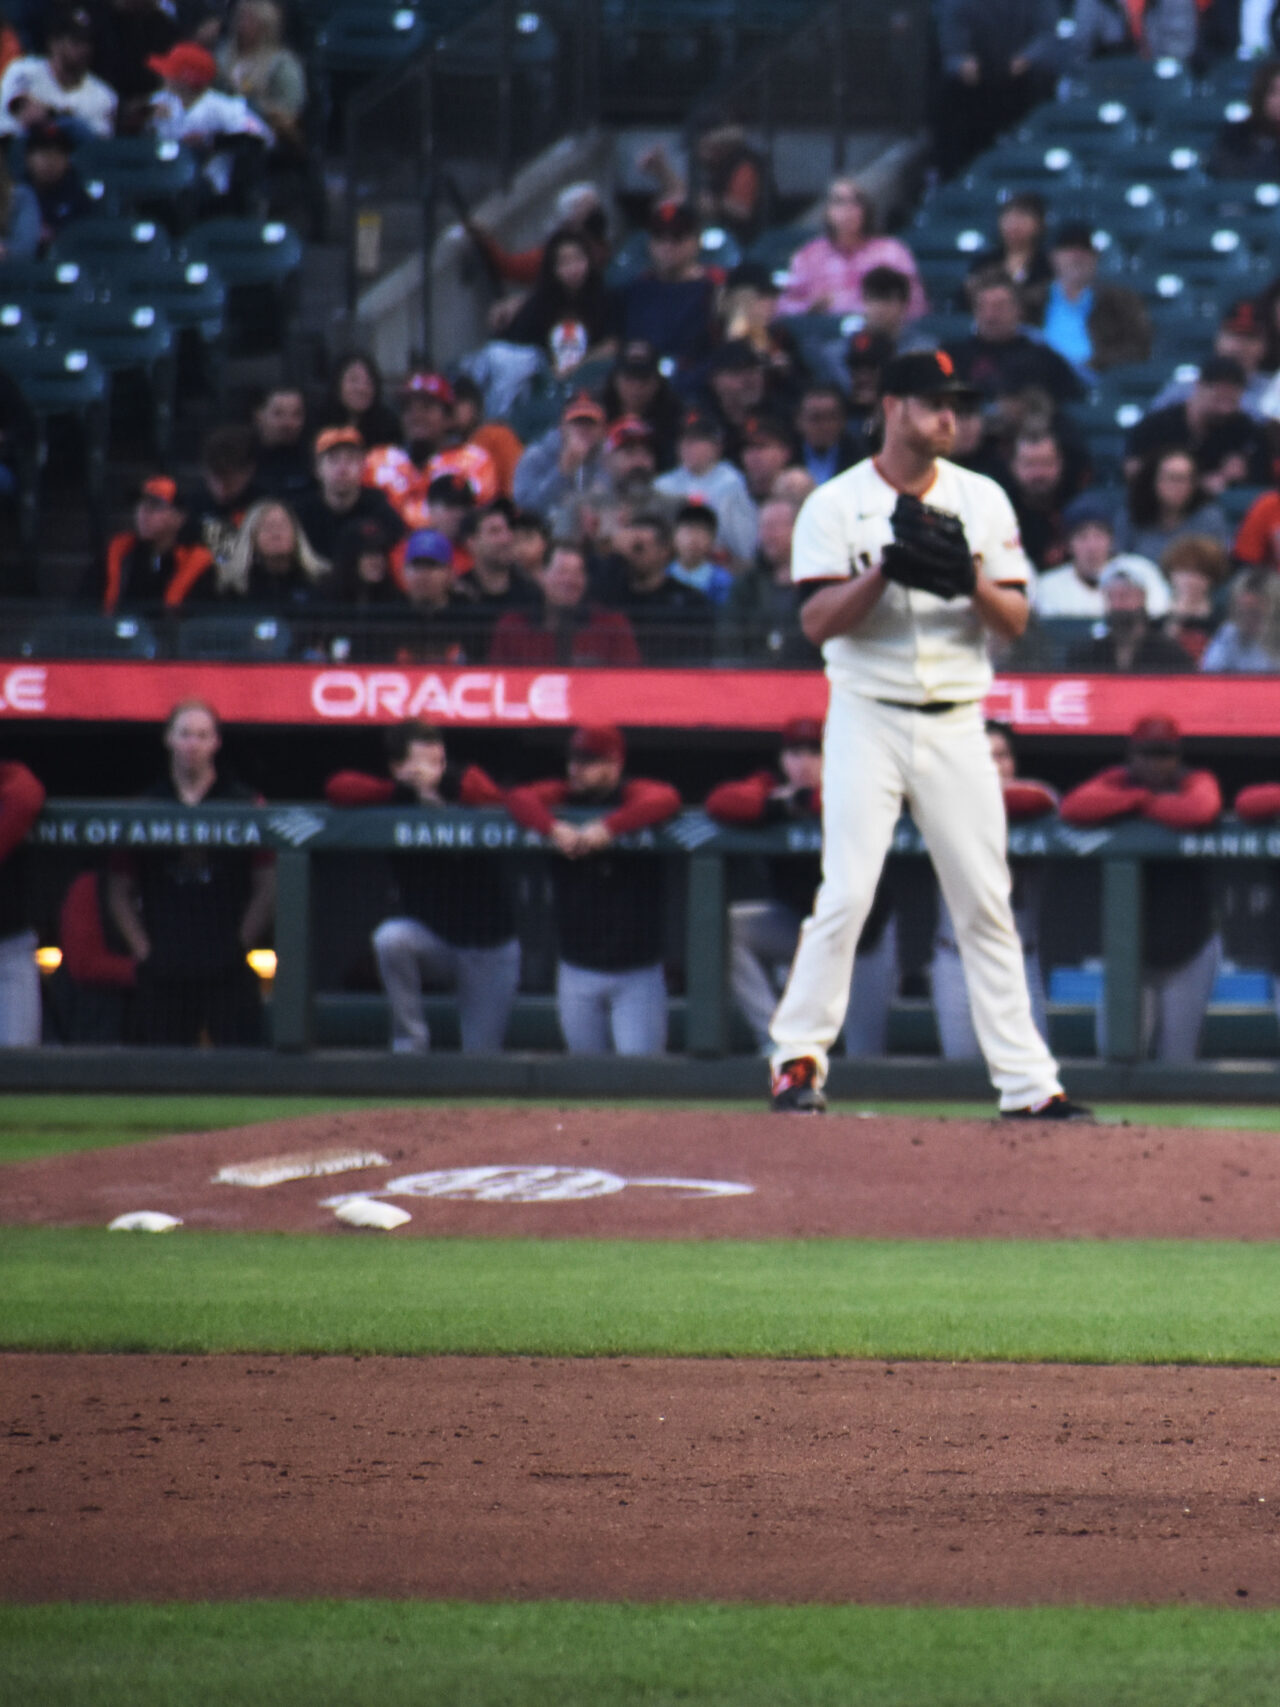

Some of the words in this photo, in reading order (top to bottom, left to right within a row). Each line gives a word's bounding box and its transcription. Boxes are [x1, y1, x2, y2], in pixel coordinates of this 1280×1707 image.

[311, 671, 569, 720] ORACLE
[130, 821, 261, 845] AMERICA
[395, 822, 474, 847] BANK
[1178, 834, 1258, 857] BANK
